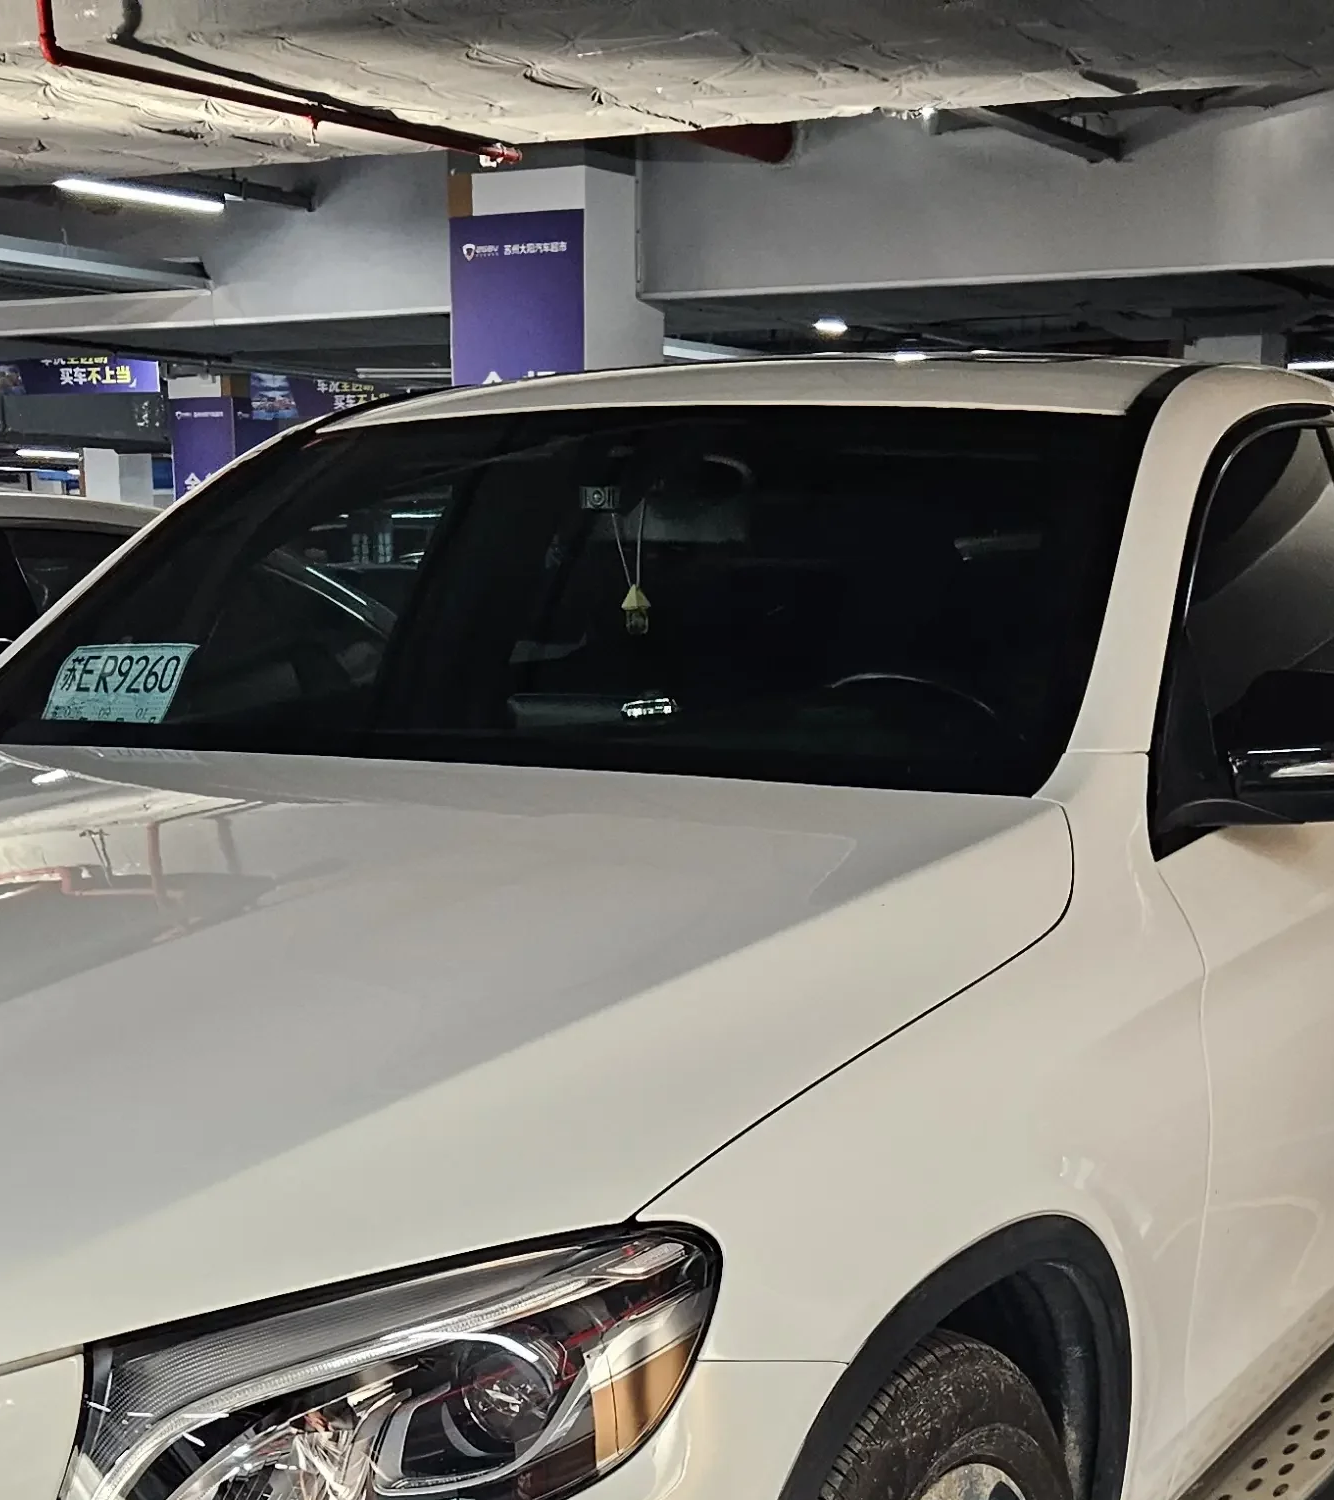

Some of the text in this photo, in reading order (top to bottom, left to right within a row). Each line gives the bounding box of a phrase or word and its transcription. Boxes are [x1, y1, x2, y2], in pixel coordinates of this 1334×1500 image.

[59, 365, 131, 385] 买车不上当
